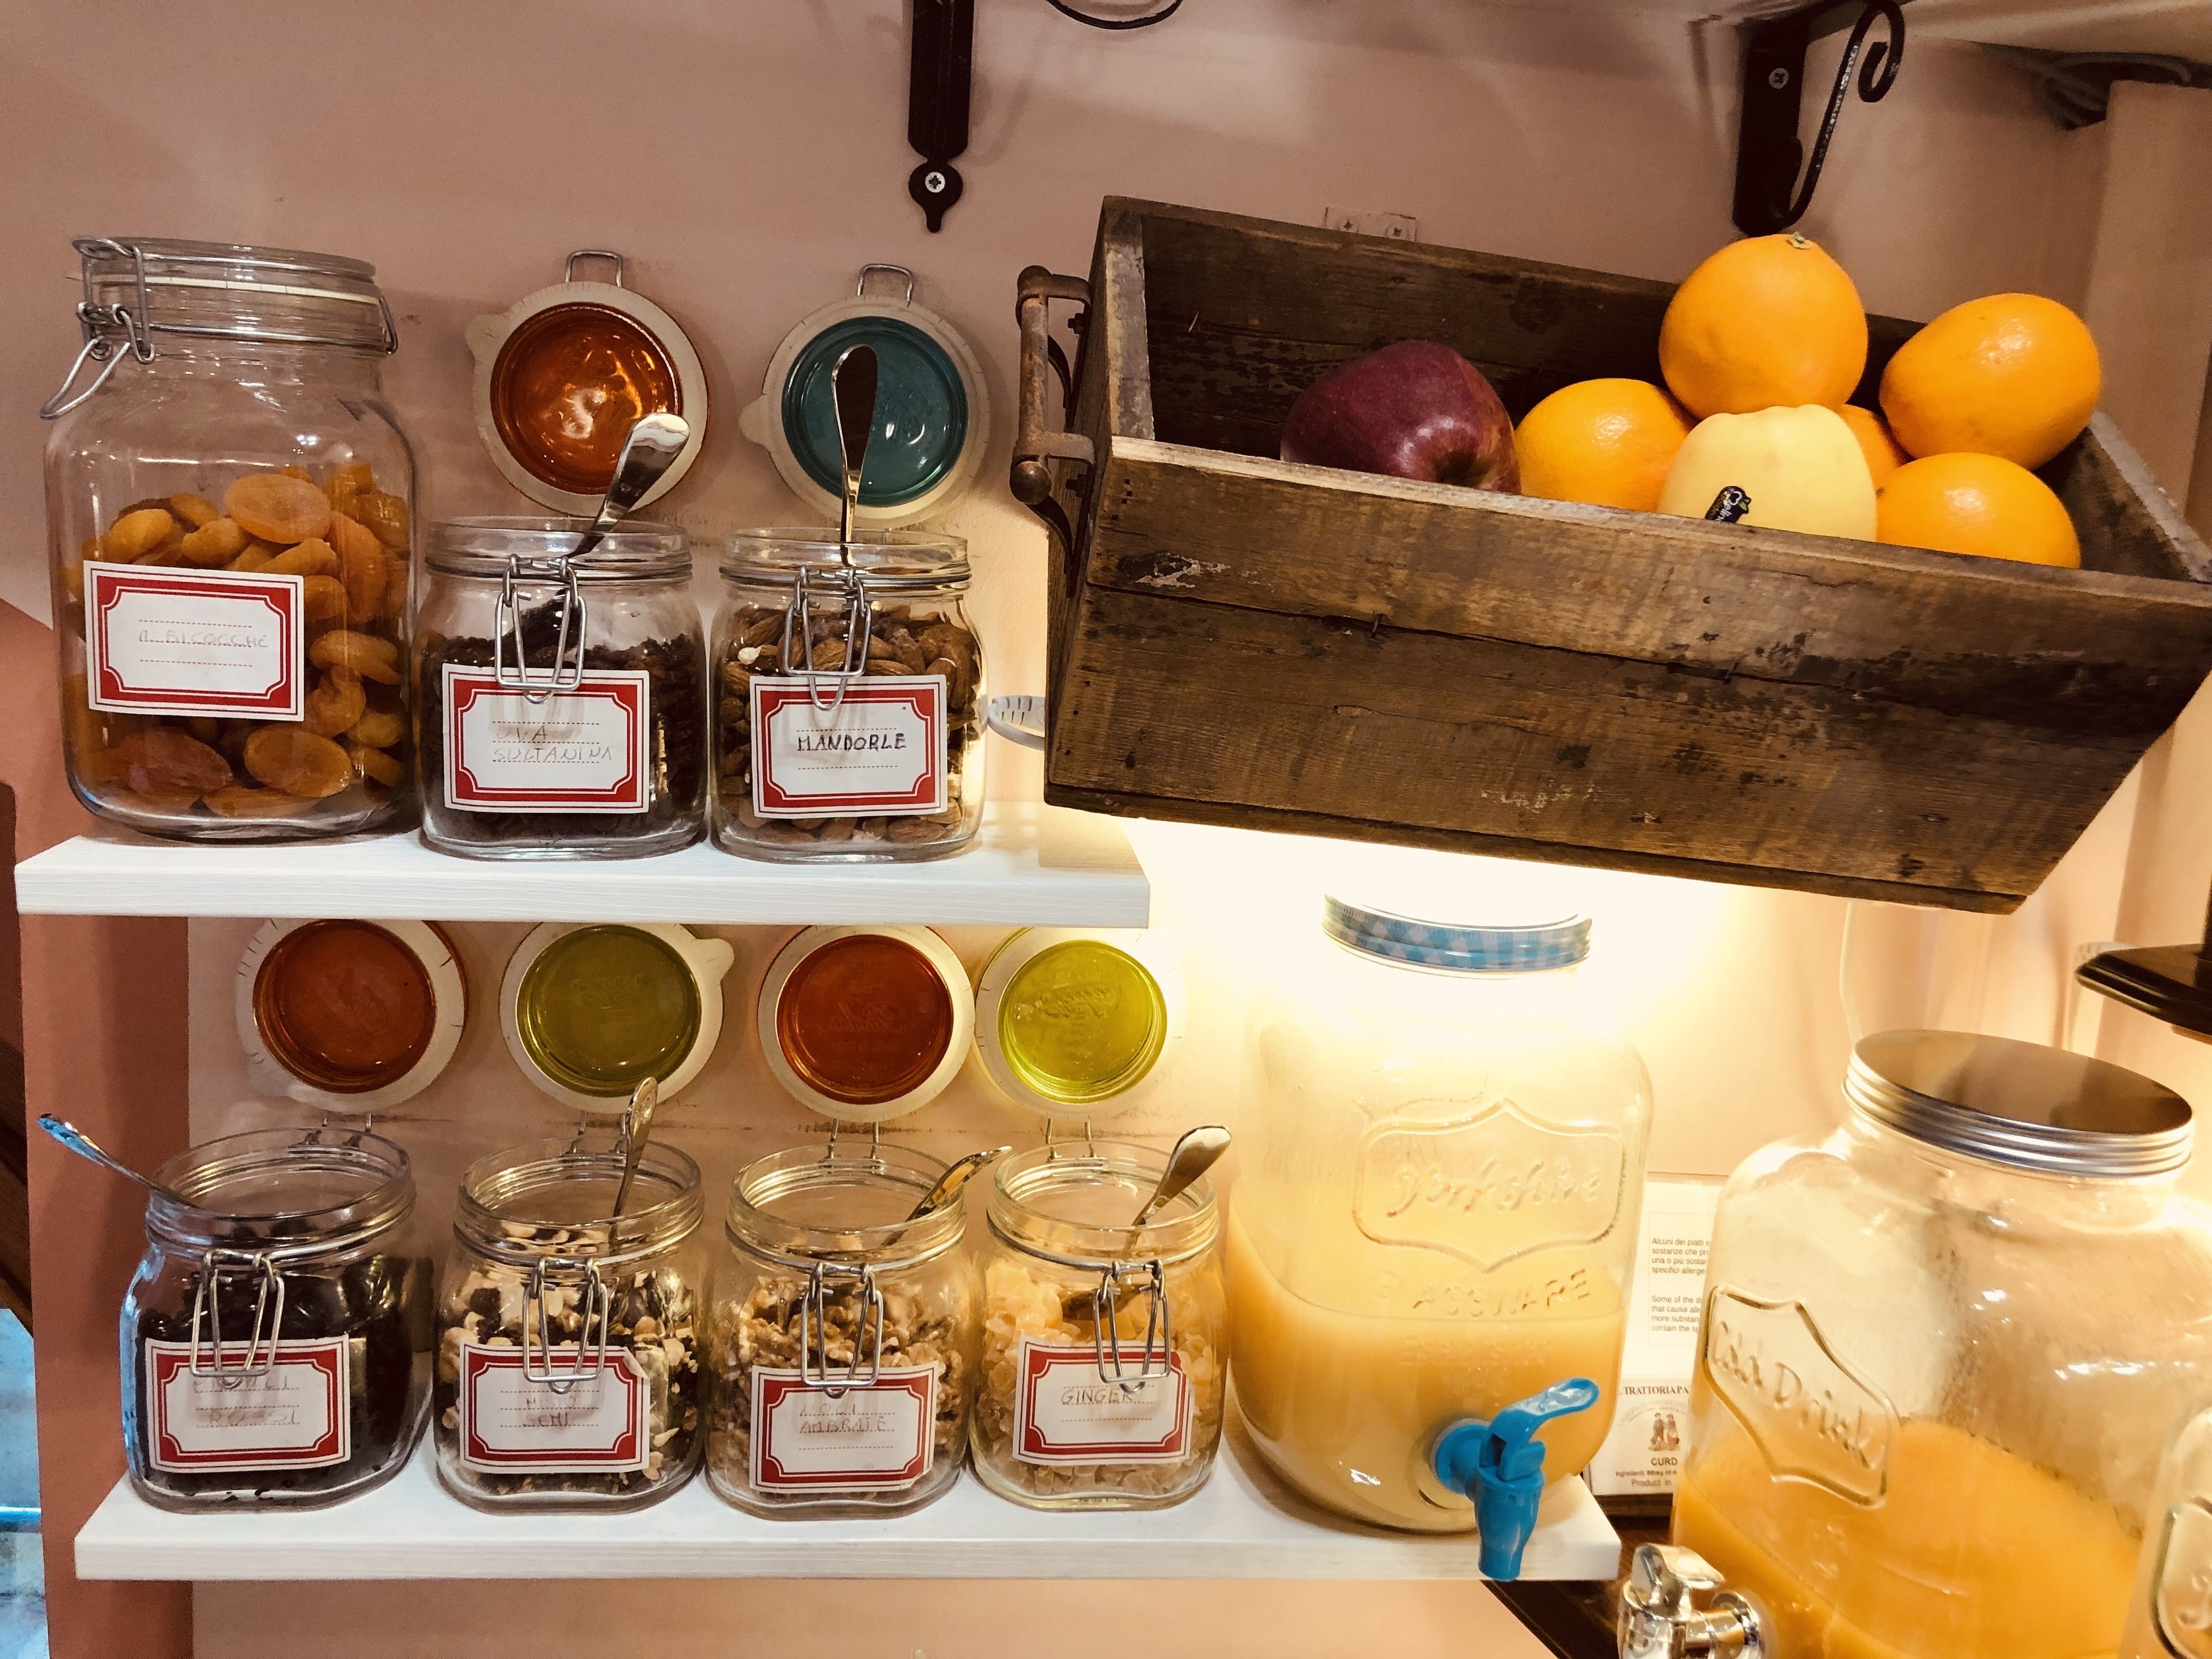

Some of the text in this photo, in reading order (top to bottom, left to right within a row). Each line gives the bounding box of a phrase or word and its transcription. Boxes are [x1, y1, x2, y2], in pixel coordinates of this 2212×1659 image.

[139, 630, 269, 648] ABICOCCHE
[797, 733, 907, 752] MANDORLE
[1623, 1385, 1676, 1395] TRATTORIA
